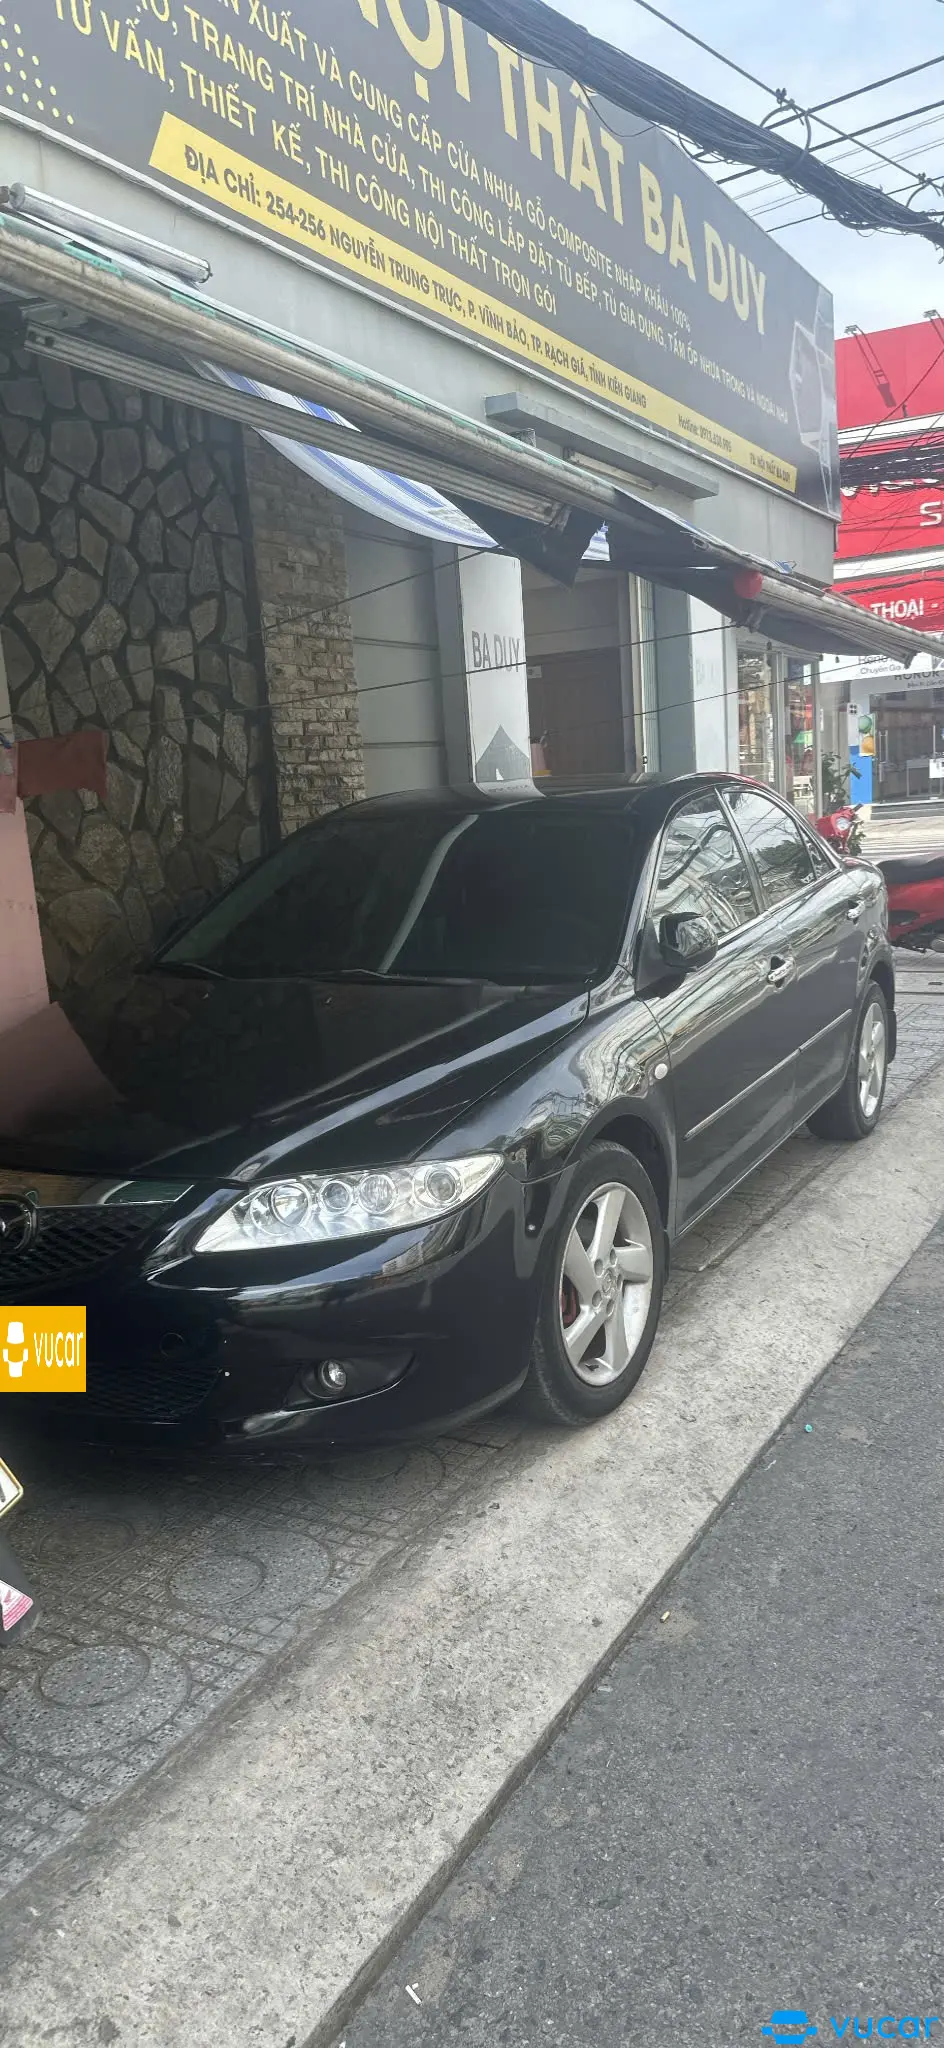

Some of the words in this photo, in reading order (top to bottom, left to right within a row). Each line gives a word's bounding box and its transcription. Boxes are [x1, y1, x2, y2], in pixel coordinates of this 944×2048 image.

[100, 9, 175, 93] VẤN,
[180, 61, 257, 136] THIẾT
[272, 119, 312, 175] KẾ,
[314, 146, 350, 193] THI
[355, 172, 410, 229] CÔNG
[414, 207, 445, 250] NỘI
[447, 228, 488, 274] THẤT
[491, 255, 531, 300] TRỌN
[533, 283, 557, 316] GÓI
[183, 5, 275, 94] TRANG
[279, 69, 317, 122] TRÍ
[322, 100, 366, 154] NHÀ
[371, 132, 416, 190] CỬA,
[418, 164, 446, 206] THI
[450, 187, 495, 237] CÔNG
[498, 215, 525, 254] LẮP
[528, 239, 554, 276] ĐẶT
[556, 256, 573, 288] TỦ
[602, 288, 617, 317] TỦ
[619, 302, 637, 329] GIA
[667, 330, 686, 361] TẤM
[313, 42, 344, 89] VÀ
[349, 69, 403, 131] CUNG
[407, 112, 442, 155] CẤP
[447, 140, 481, 186] CỬA
[483, 166, 524, 217] NHỰA
[548, 216, 613, 279] COMPOSITE
[615, 262, 642, 298] NHẬP
[670, 304, 691, 333] 100%
[639, 161, 697, 283] BA
[703, 221, 766, 336] DUY
[184, 144, 220, 185] ĐỊA
[223, 168, 261, 208] CHỈ:
[265, 190, 326, 241] 254-256
[329, 223, 386, 273] NGUYỄN
[388, 256, 430, 295] TRUNG
[431, 279, 466, 318] TRỰC,
[467, 299, 477, 320] P.
[478, 305, 504, 335] VĨNH
[530, 333, 543, 355] TP.
[544, 341, 569, 369] RẠCH
[607, 375, 624, 398] KIÊN
[624, 384, 647, 409] GIANG
[869, 597, 924, 621] THOẠI
[919, 501, 944, 527] S
[471, 630, 492, 669] BA
[493, 633, 521, 673] DUY
